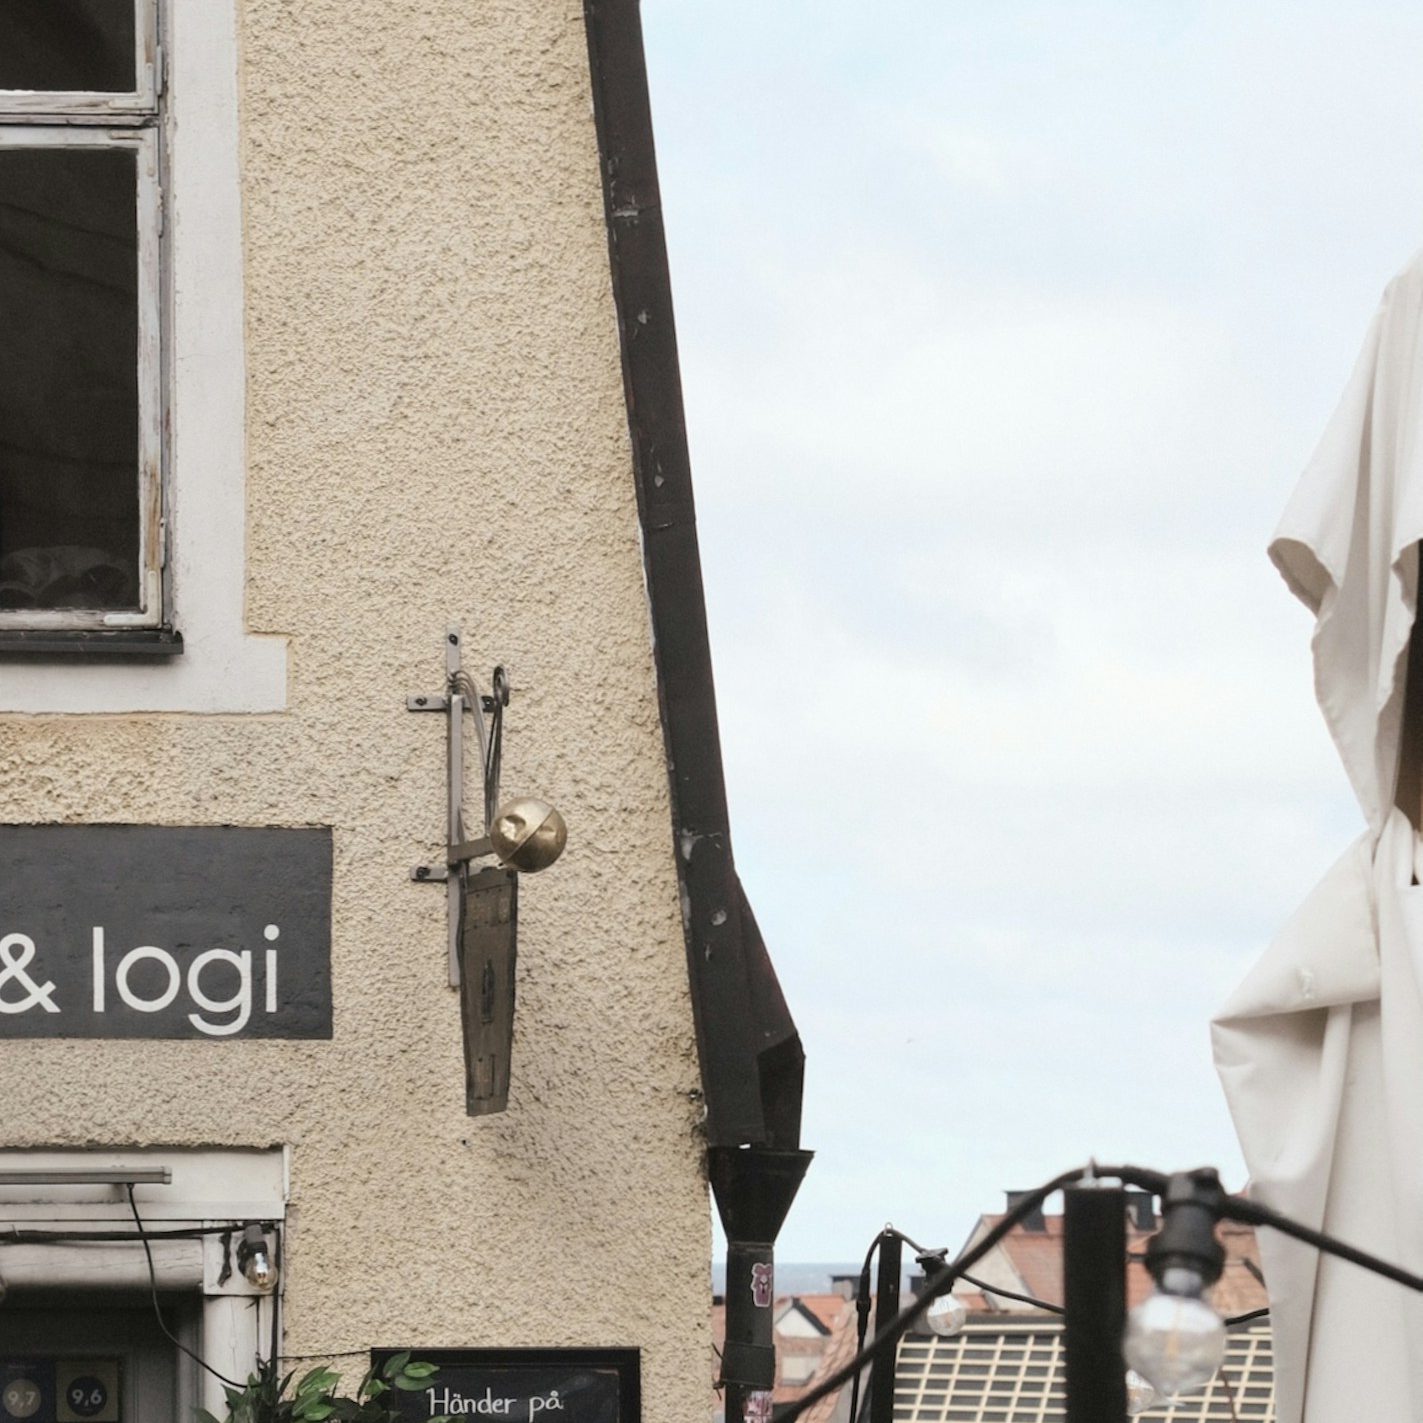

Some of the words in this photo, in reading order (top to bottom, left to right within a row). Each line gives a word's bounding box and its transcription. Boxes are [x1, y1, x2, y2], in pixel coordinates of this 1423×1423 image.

[91, 925, 280, 1036] logi
[7, 1391, 36, 1408] 9,7
[72, 1389, 102, 1407] 9,6
[426, 1387, 517, 1416] Händer
[529, 1390, 565, 1423] på
